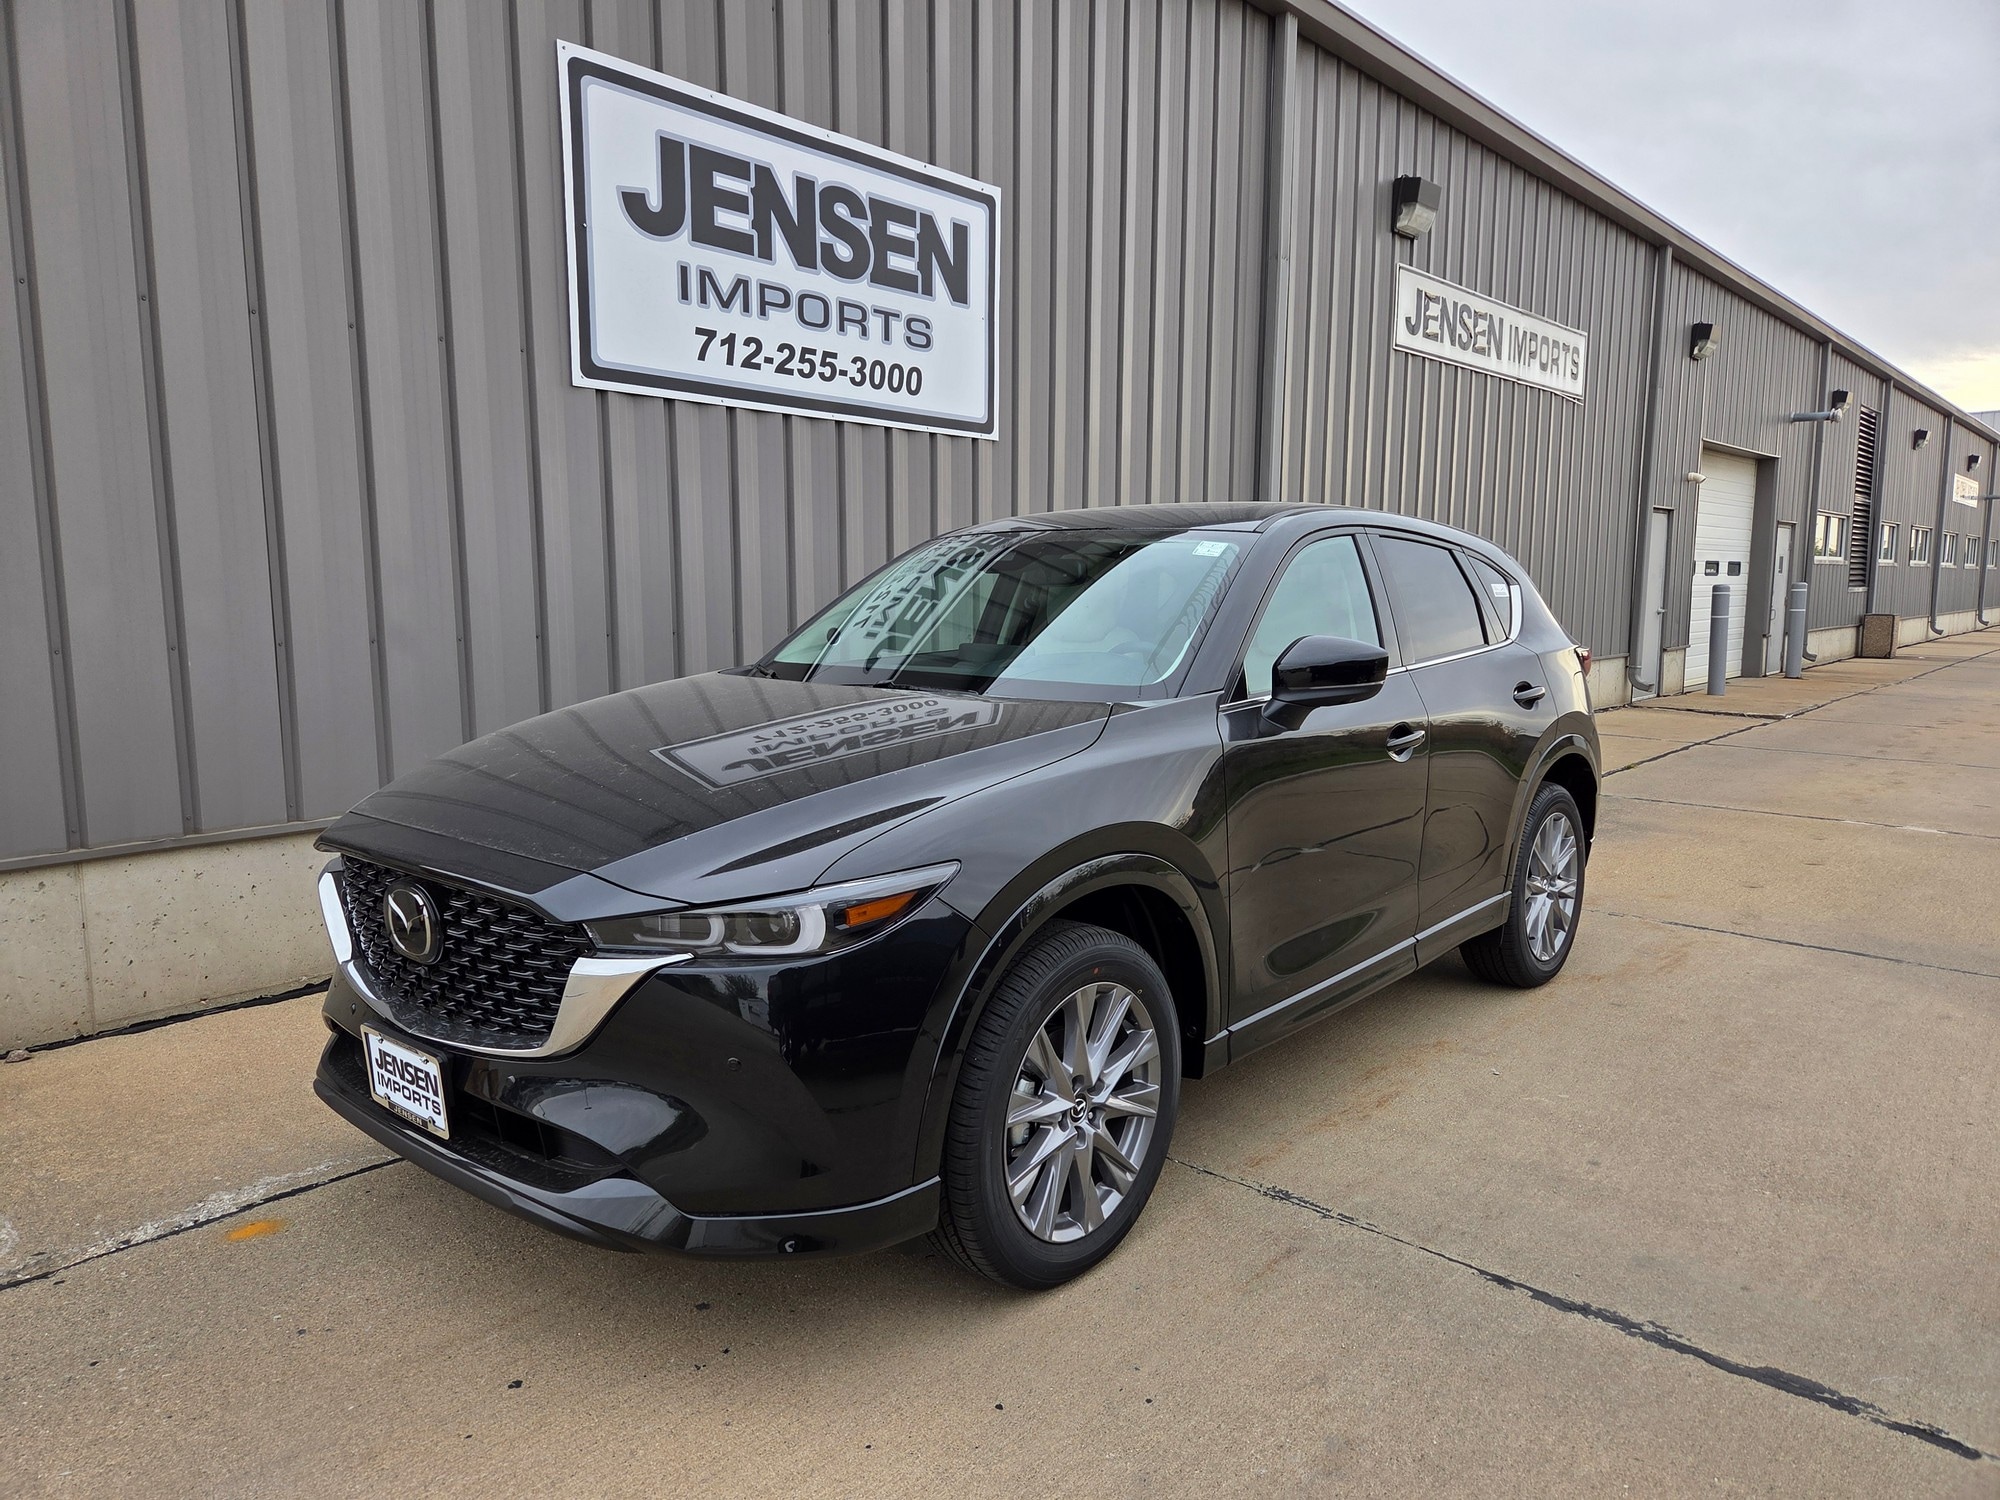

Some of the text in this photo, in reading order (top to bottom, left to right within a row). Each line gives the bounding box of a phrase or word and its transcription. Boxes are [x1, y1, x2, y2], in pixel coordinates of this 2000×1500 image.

[617, 130, 971, 308] JENSEN
[678, 262, 933, 351] IMPORTS
[1405, 287, 1581, 381] JENSEN IMPORTS
[694, 327, 923, 396] 712-255-3000
[374, 1047, 440, 1098] JENSEN
[376, 1071, 441, 1116] IMPORTS
[393, 1105, 423, 1126] JENSEN
